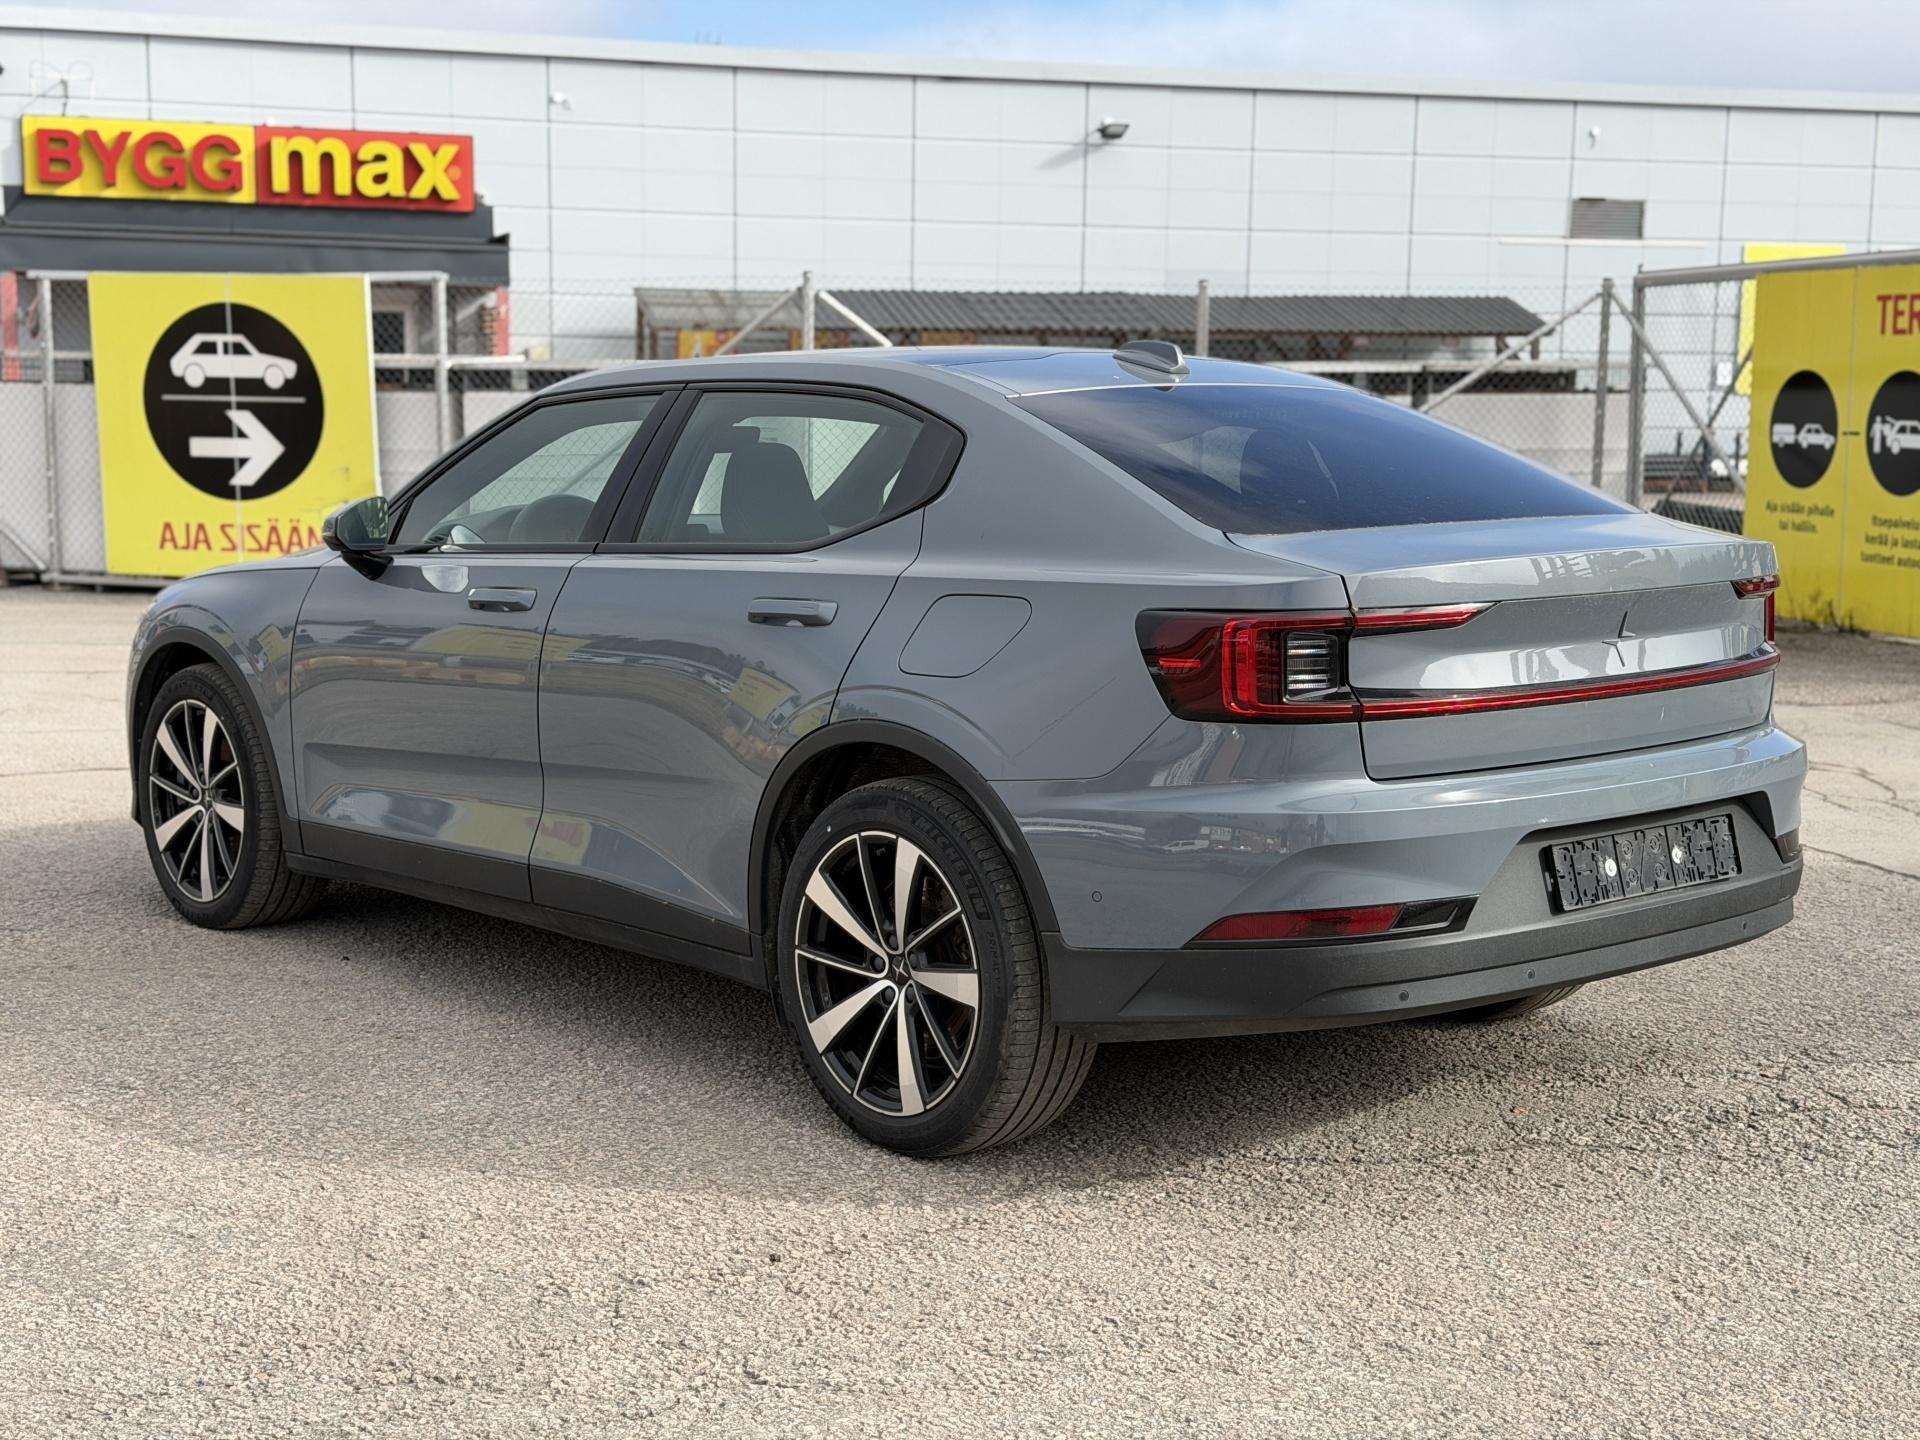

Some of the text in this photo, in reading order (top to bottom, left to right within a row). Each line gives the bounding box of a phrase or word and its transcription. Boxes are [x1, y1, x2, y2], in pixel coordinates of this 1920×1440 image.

[36, 128, 461, 201] BYGG max
[159, 521, 212, 551] AJA
[911, 814, 991, 921] MICHELIN
